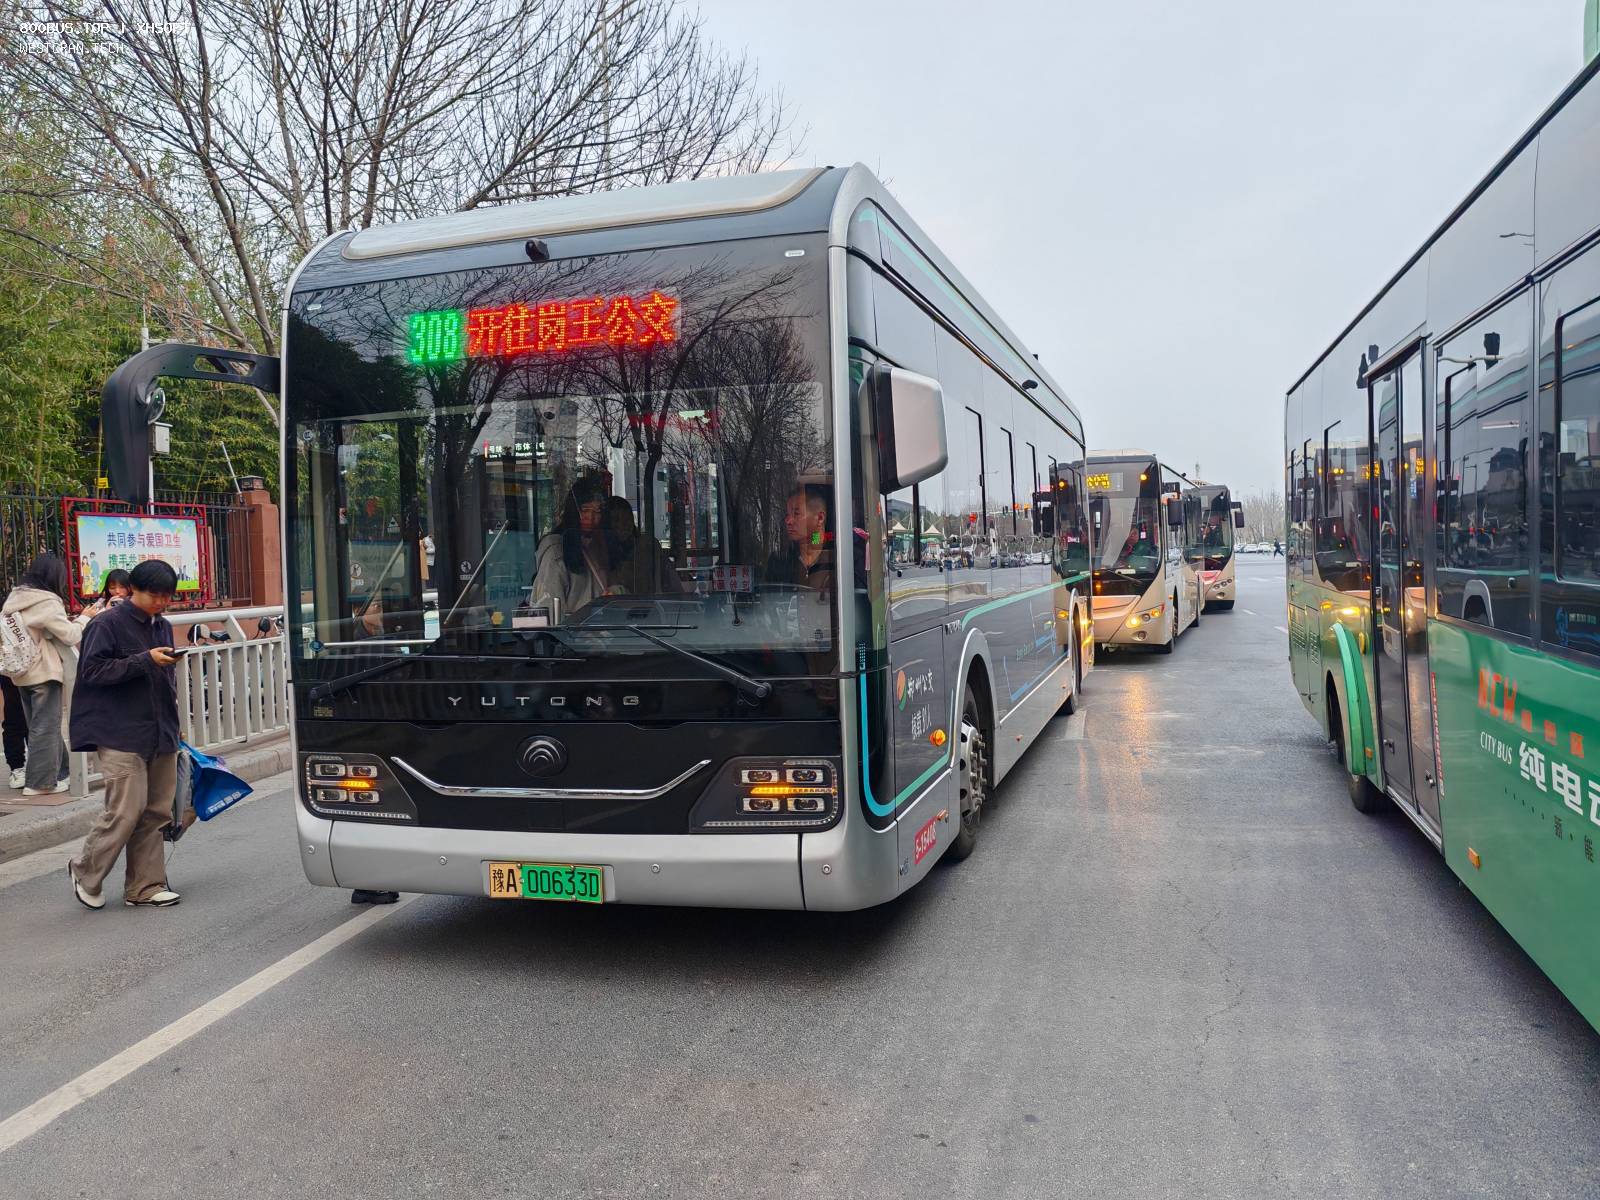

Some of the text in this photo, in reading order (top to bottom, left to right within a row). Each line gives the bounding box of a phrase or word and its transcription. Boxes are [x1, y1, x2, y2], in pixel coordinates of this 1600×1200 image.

[410, 313, 460, 361] 308
[107, 532, 182, 548] 共同参与爱国卫生
[447, 695, 640, 707] YUTONG
[1480, 731, 1513, 765] CITY BUS
